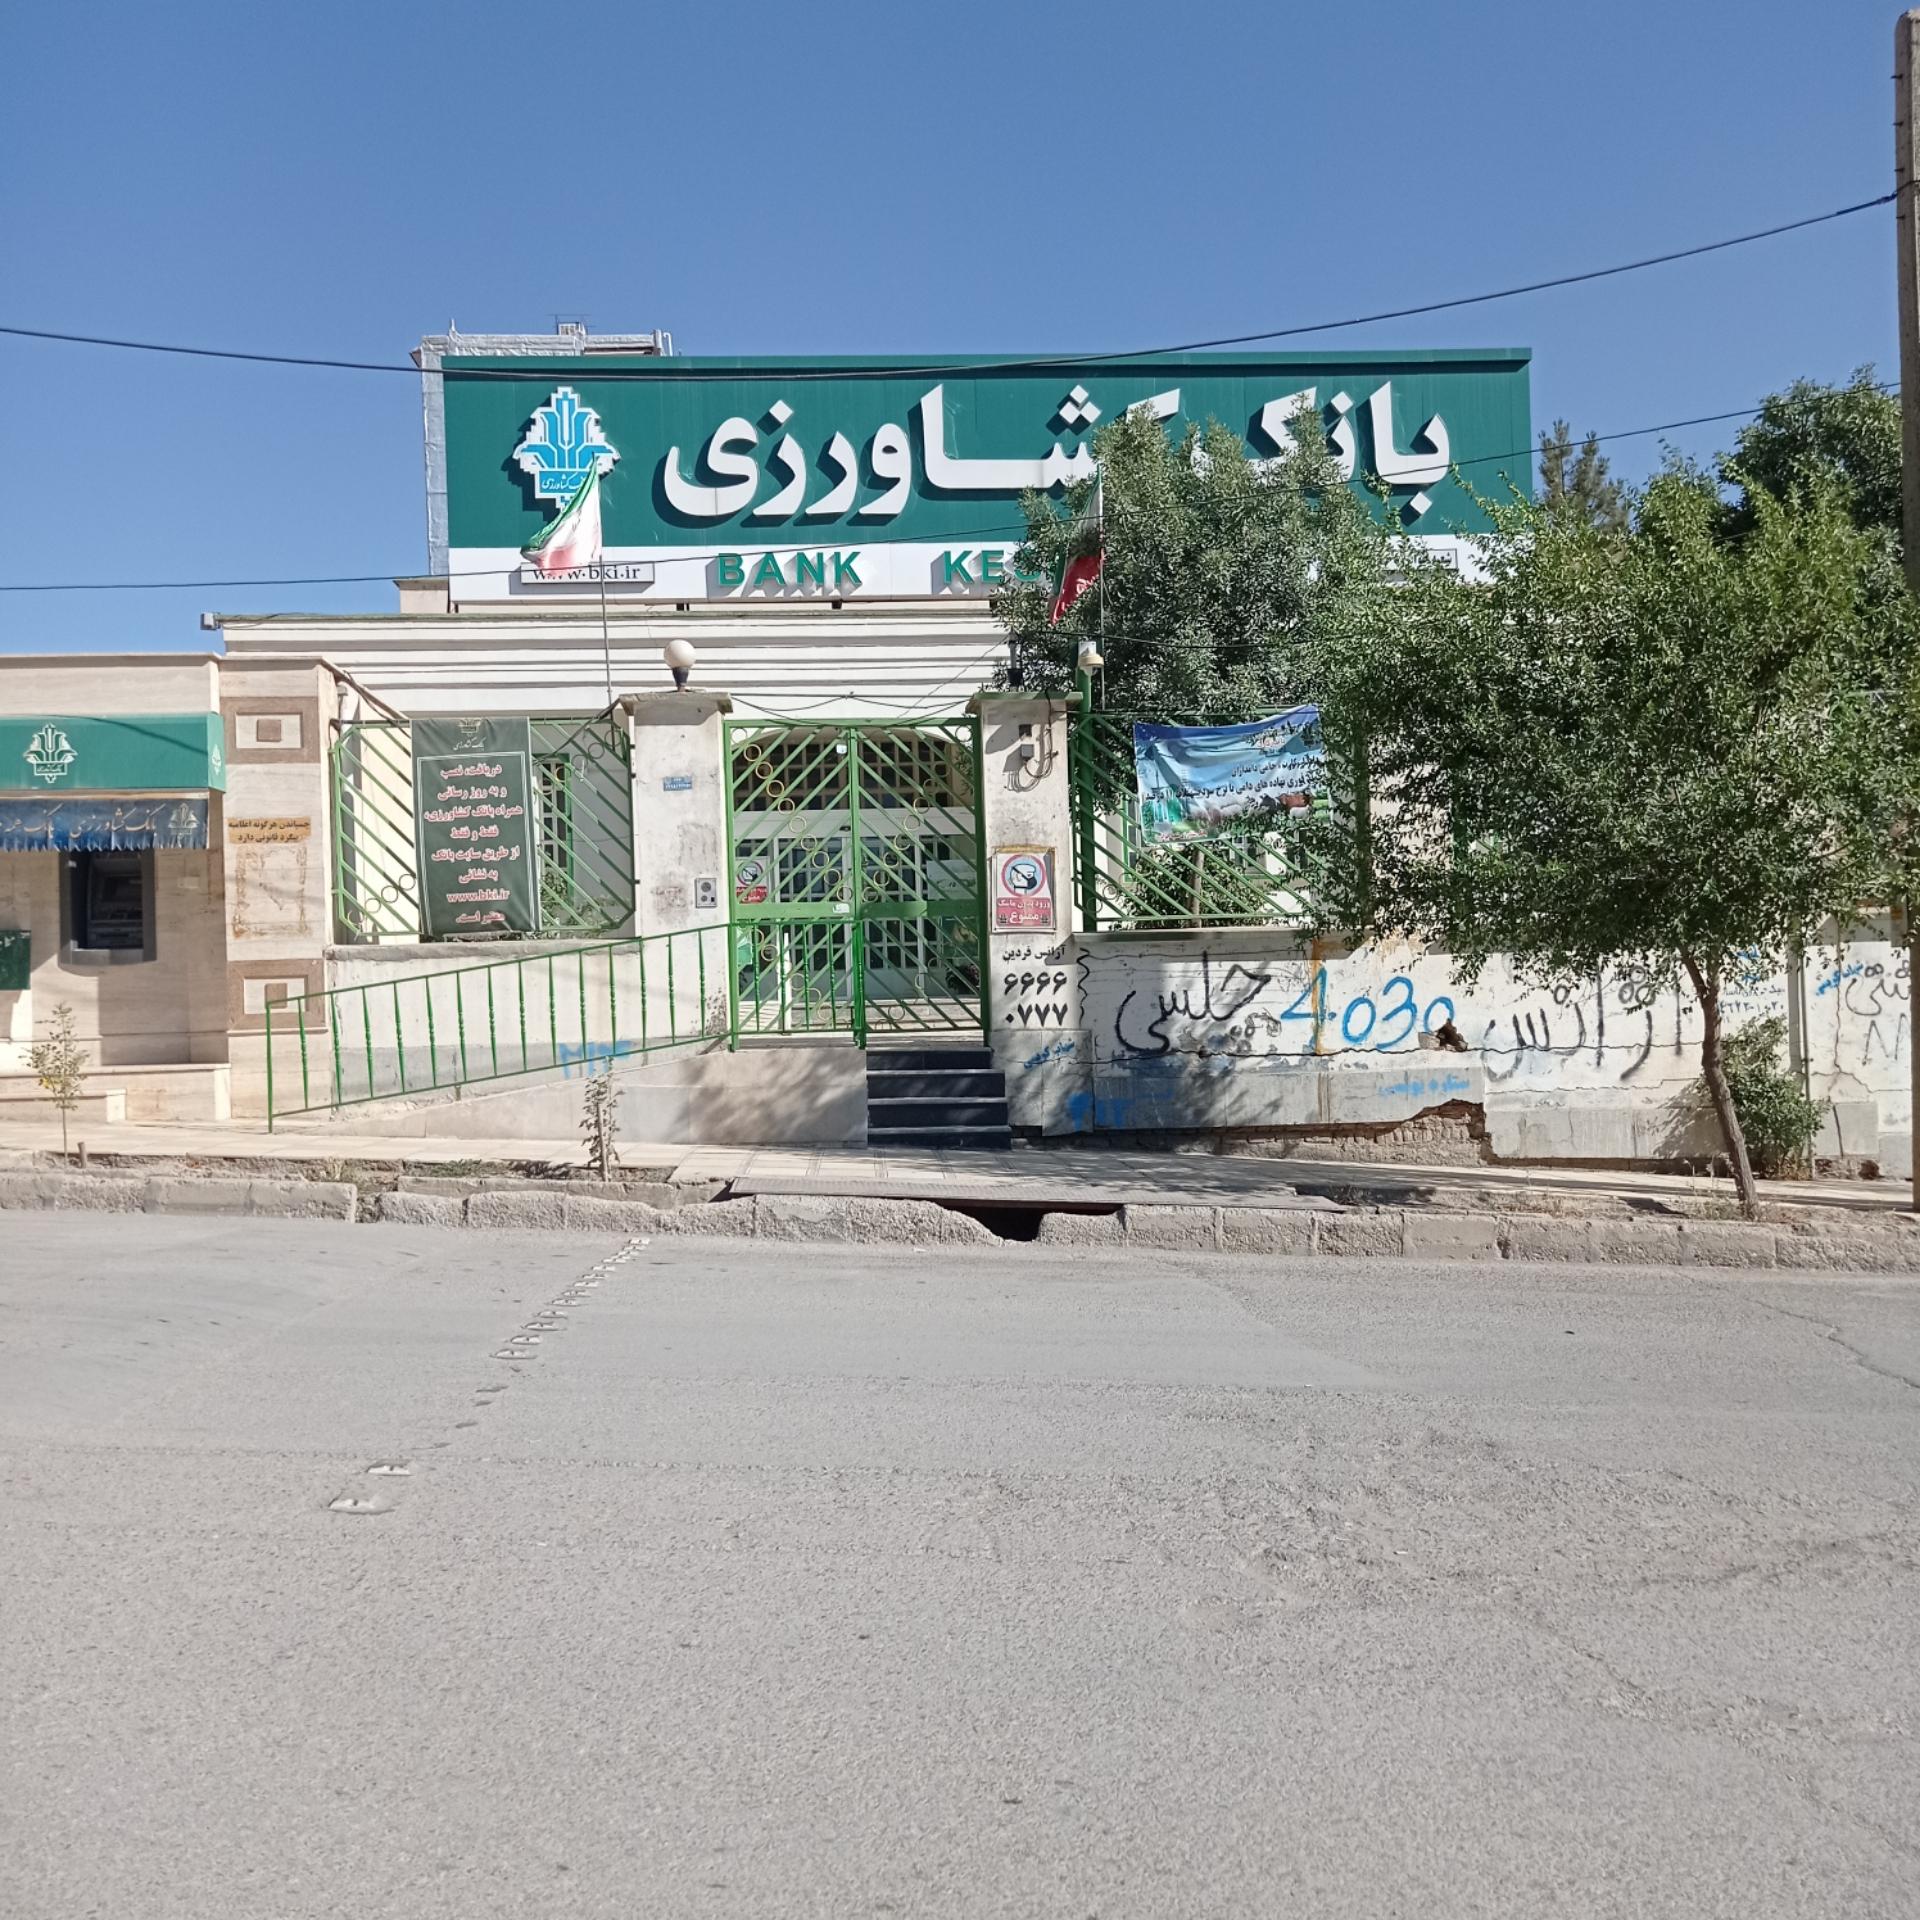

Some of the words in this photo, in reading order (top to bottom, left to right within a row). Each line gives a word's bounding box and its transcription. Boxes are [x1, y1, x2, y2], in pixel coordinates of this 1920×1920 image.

[717, 551, 861, 586] BANK
[469, 786, 488, 799] روز
[488, 785, 499, 798] به
[499, 786, 507, 798] و
[471, 804, 494, 819] بانک
[495, 804, 523, 819] همراه
[23, 803, 63, 839] بانک
[69, 808, 136, 837] کشاورزی
[126, 803, 166, 837] بانک
[450, 826, 470, 839] فقط
[471, 831, 479, 841] و
[479, 824, 500, 838] فقط
[431, 848, 455, 863] بانک
[455, 847, 482, 861] سایت
[481, 845, 509, 861] طریق
[509, 845, 520, 861] از
[458, 867, 487, 884] نشانی
[487, 868, 499, 882] به
[446, 888, 510, 902] www.bki.ir
[1010, 911, 1039, 925] ممنوع
[1003, 971, 1068, 996] ۶۶۶۶
[1004, 1003, 1069, 1028] ۰۷۷۷
